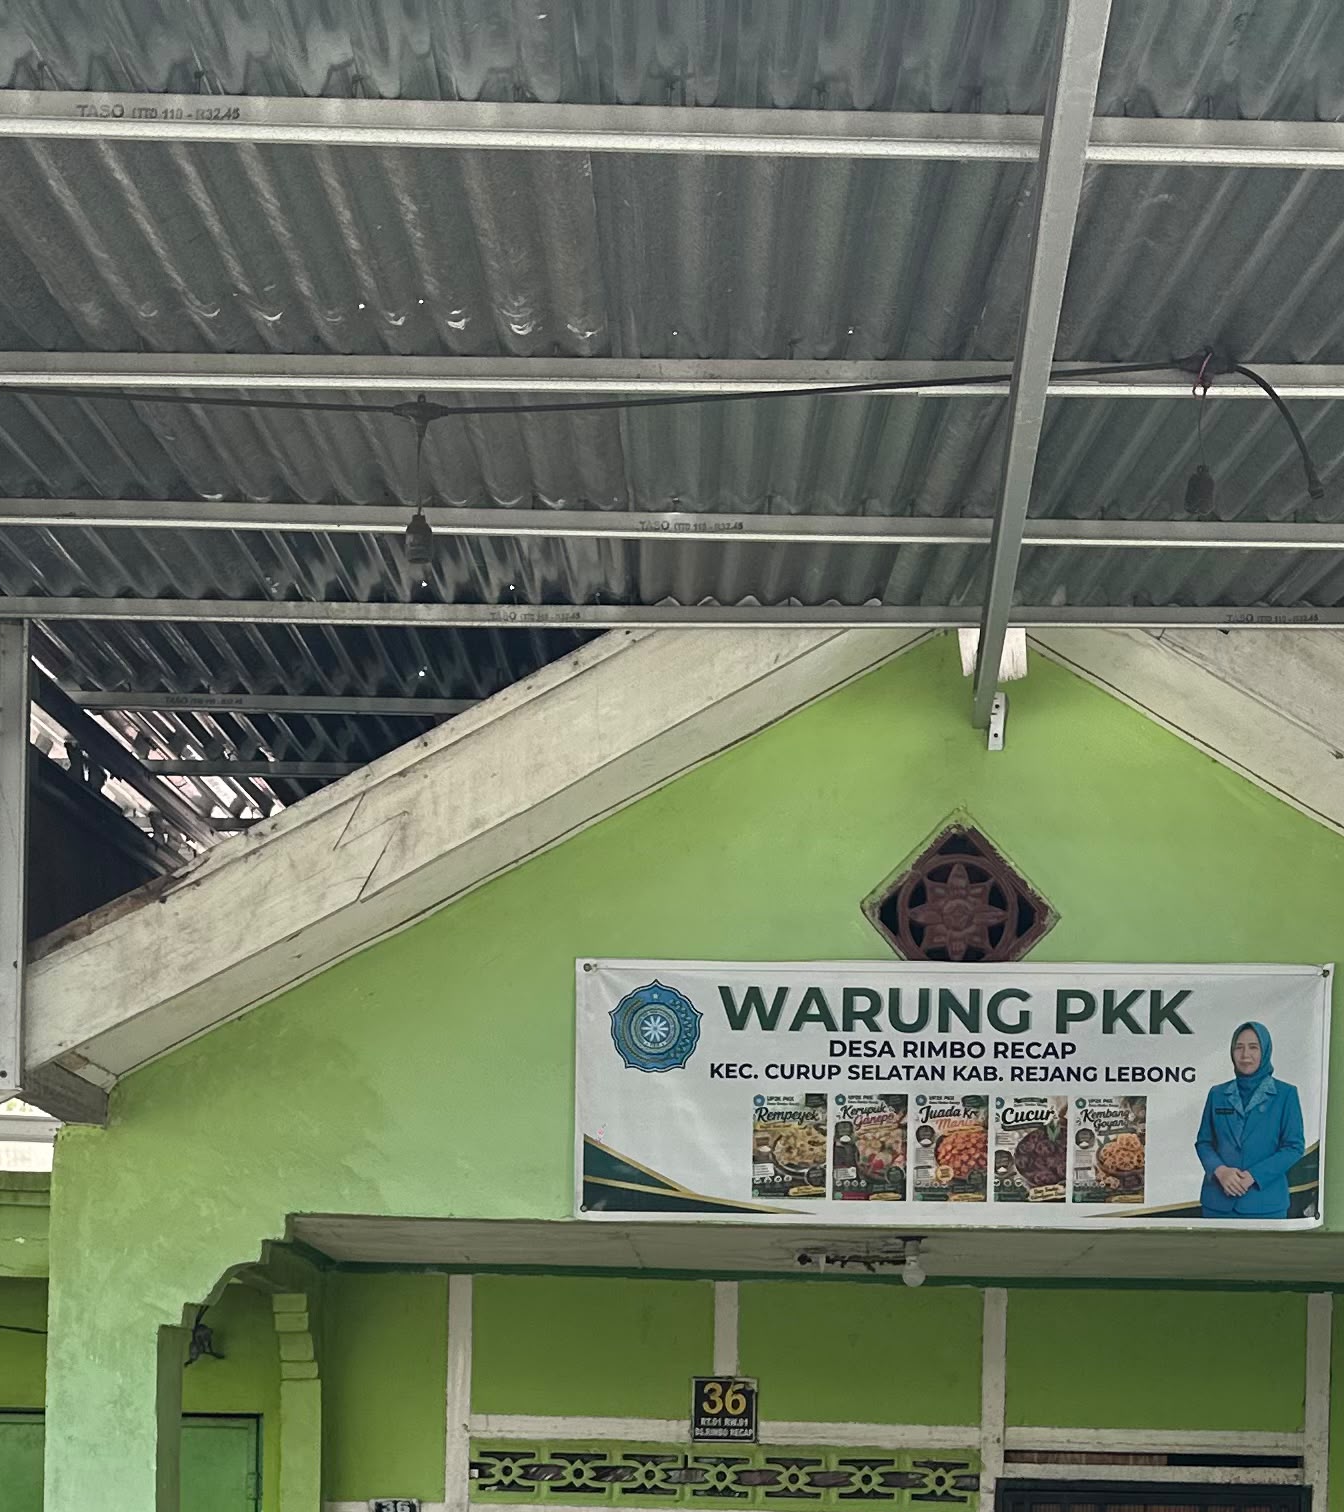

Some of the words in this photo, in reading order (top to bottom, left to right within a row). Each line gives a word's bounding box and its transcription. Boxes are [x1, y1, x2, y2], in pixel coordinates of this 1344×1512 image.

[718, 985, 1032, 1034] WARUNG
[1056, 988, 1194, 1035] PKK
[829, 1040, 896, 1059] DESA
[903, 1041, 986, 1059] RIMBO
[993, 1042, 1077, 1060] RECAP
[709, 1063, 759, 1080] KEC.
[764, 1063, 842, 1081] CURUP
[847, 1065, 946, 1082] SELATAN
[952, 1066, 1004, 1082] KAB.
[1010, 1066, 1098, 1083] REJANG
[1105, 1066, 1197, 1083] LEBONG
[755, 1106, 820, 1126] Rempeyek
[1001, 1106, 1055, 1125] Cucur
[1080, 1108, 1130, 1123] Kembang
[703, 1382, 747, 1415] 36
